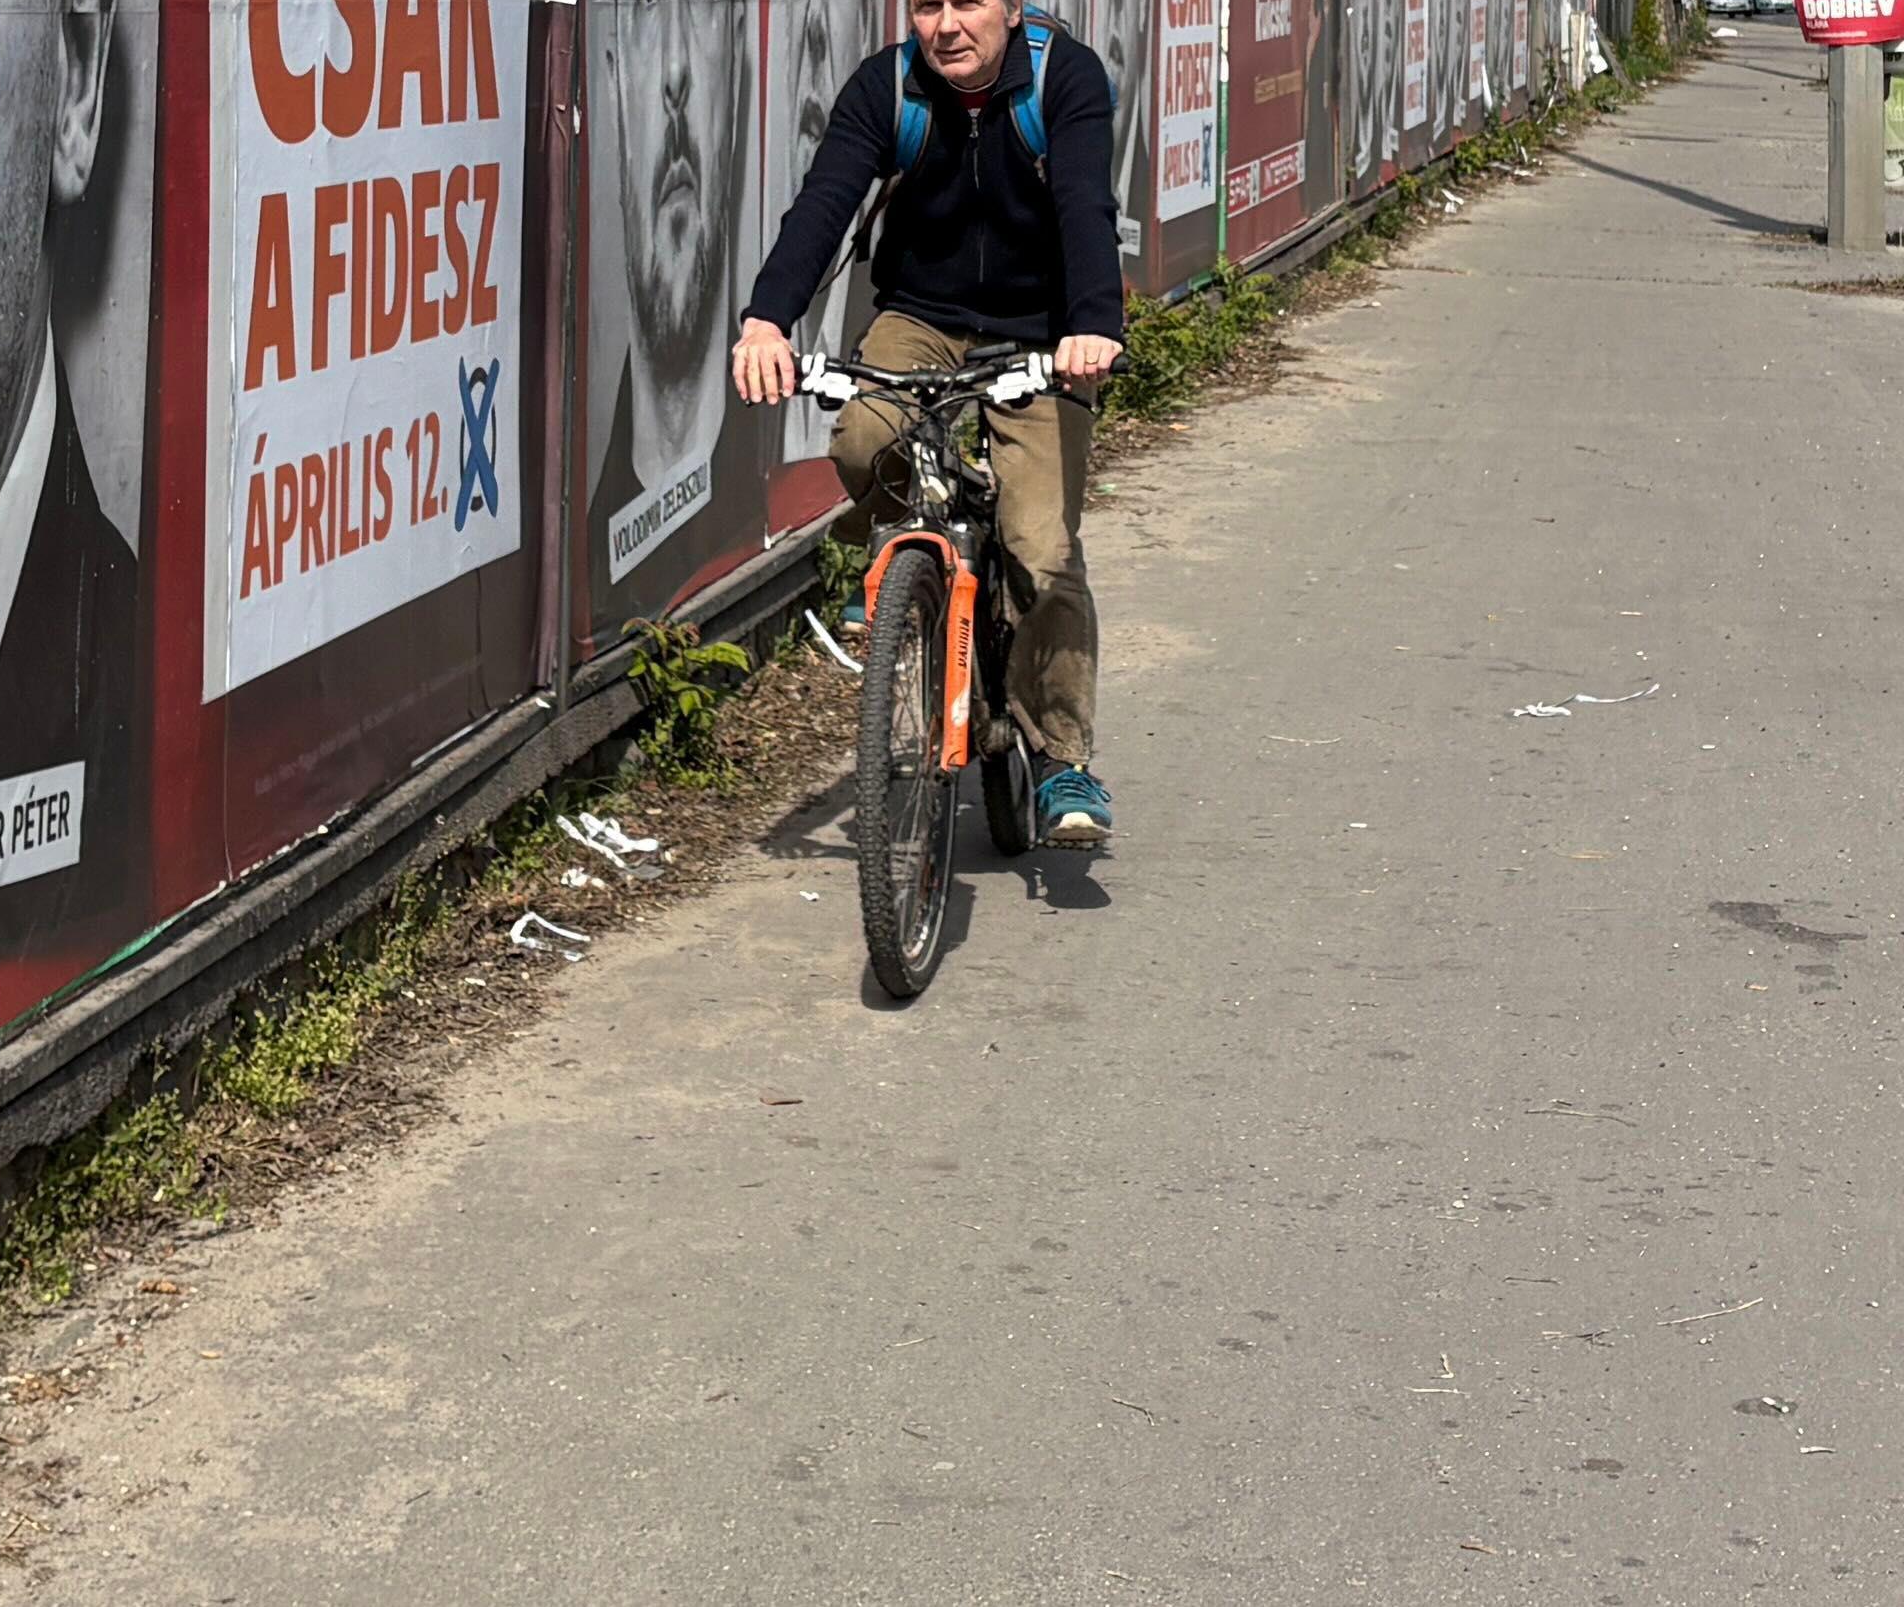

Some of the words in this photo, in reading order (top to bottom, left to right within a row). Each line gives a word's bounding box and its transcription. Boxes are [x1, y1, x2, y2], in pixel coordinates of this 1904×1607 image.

[1164, 45, 1174, 114] A
[1175, 41, 1213, 110] FIDESZ
[243, 192, 295, 390] A
[309, 160, 498, 365] FIDESZ
[239, 411, 393, 599] ÁPRILIS
[406, 416, 449, 544] 12.
[613, 499, 662, 563] VOLODIMIR
[663, 461, 707, 524] ZELENSZKIJ
[12, 785, 70, 855] PÉTER
